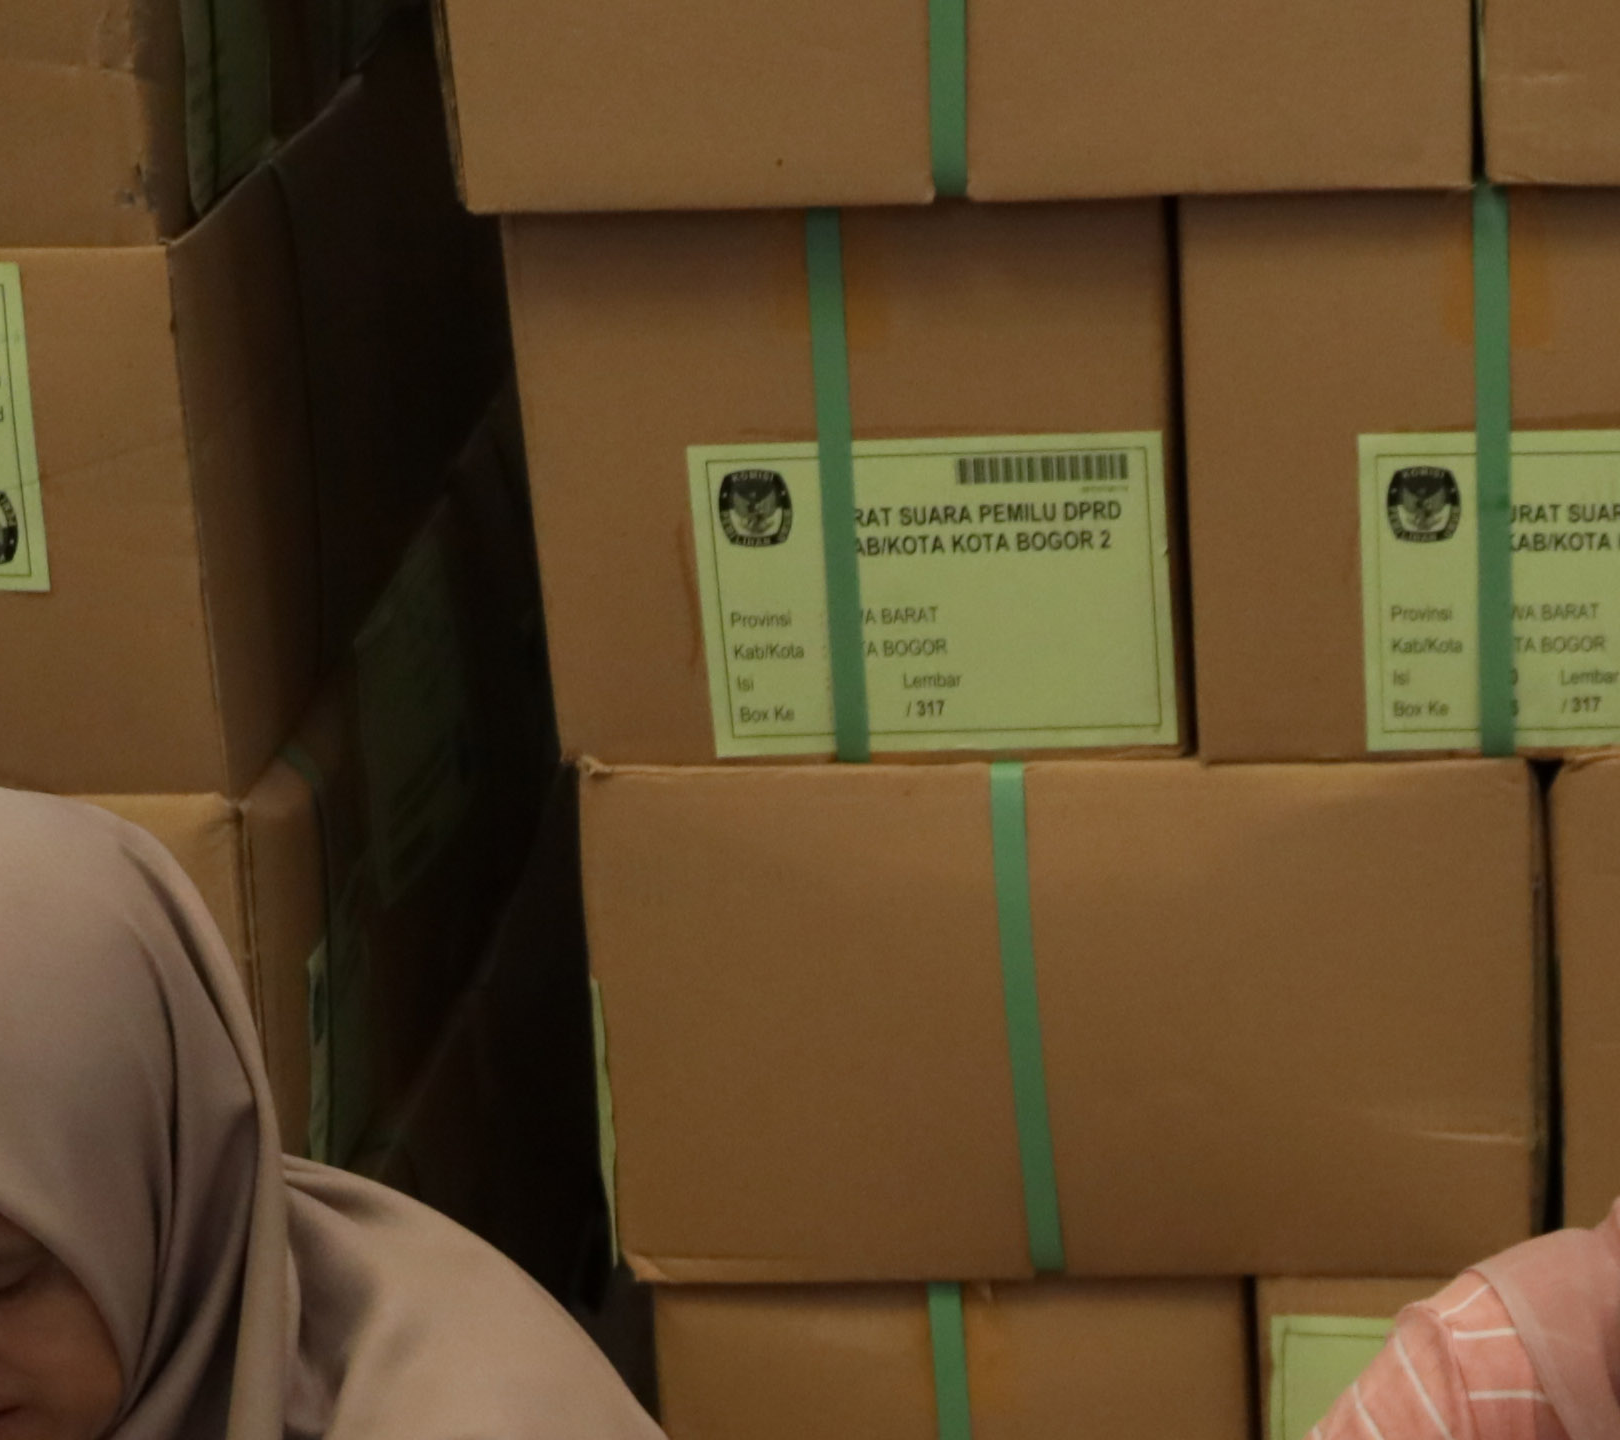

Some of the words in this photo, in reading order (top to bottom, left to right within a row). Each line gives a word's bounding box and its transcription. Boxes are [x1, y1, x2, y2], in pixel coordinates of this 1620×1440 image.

[900, 505, 972, 526] SUARA
[979, 503, 1056, 523] PEMILU
[1064, 500, 1121, 520] DPRD
[855, 536, 945, 556] AB/KOTA
[952, 534, 1009, 553] KOTA
[1016, 532, 1093, 551] BOGOR
[1101, 530, 1112, 549] 2
[881, 606, 938, 623] BARAT
[883, 639, 947, 656] BOGOR
[903, 673, 962, 689] Lembar
[917, 700, 945, 717] 317
